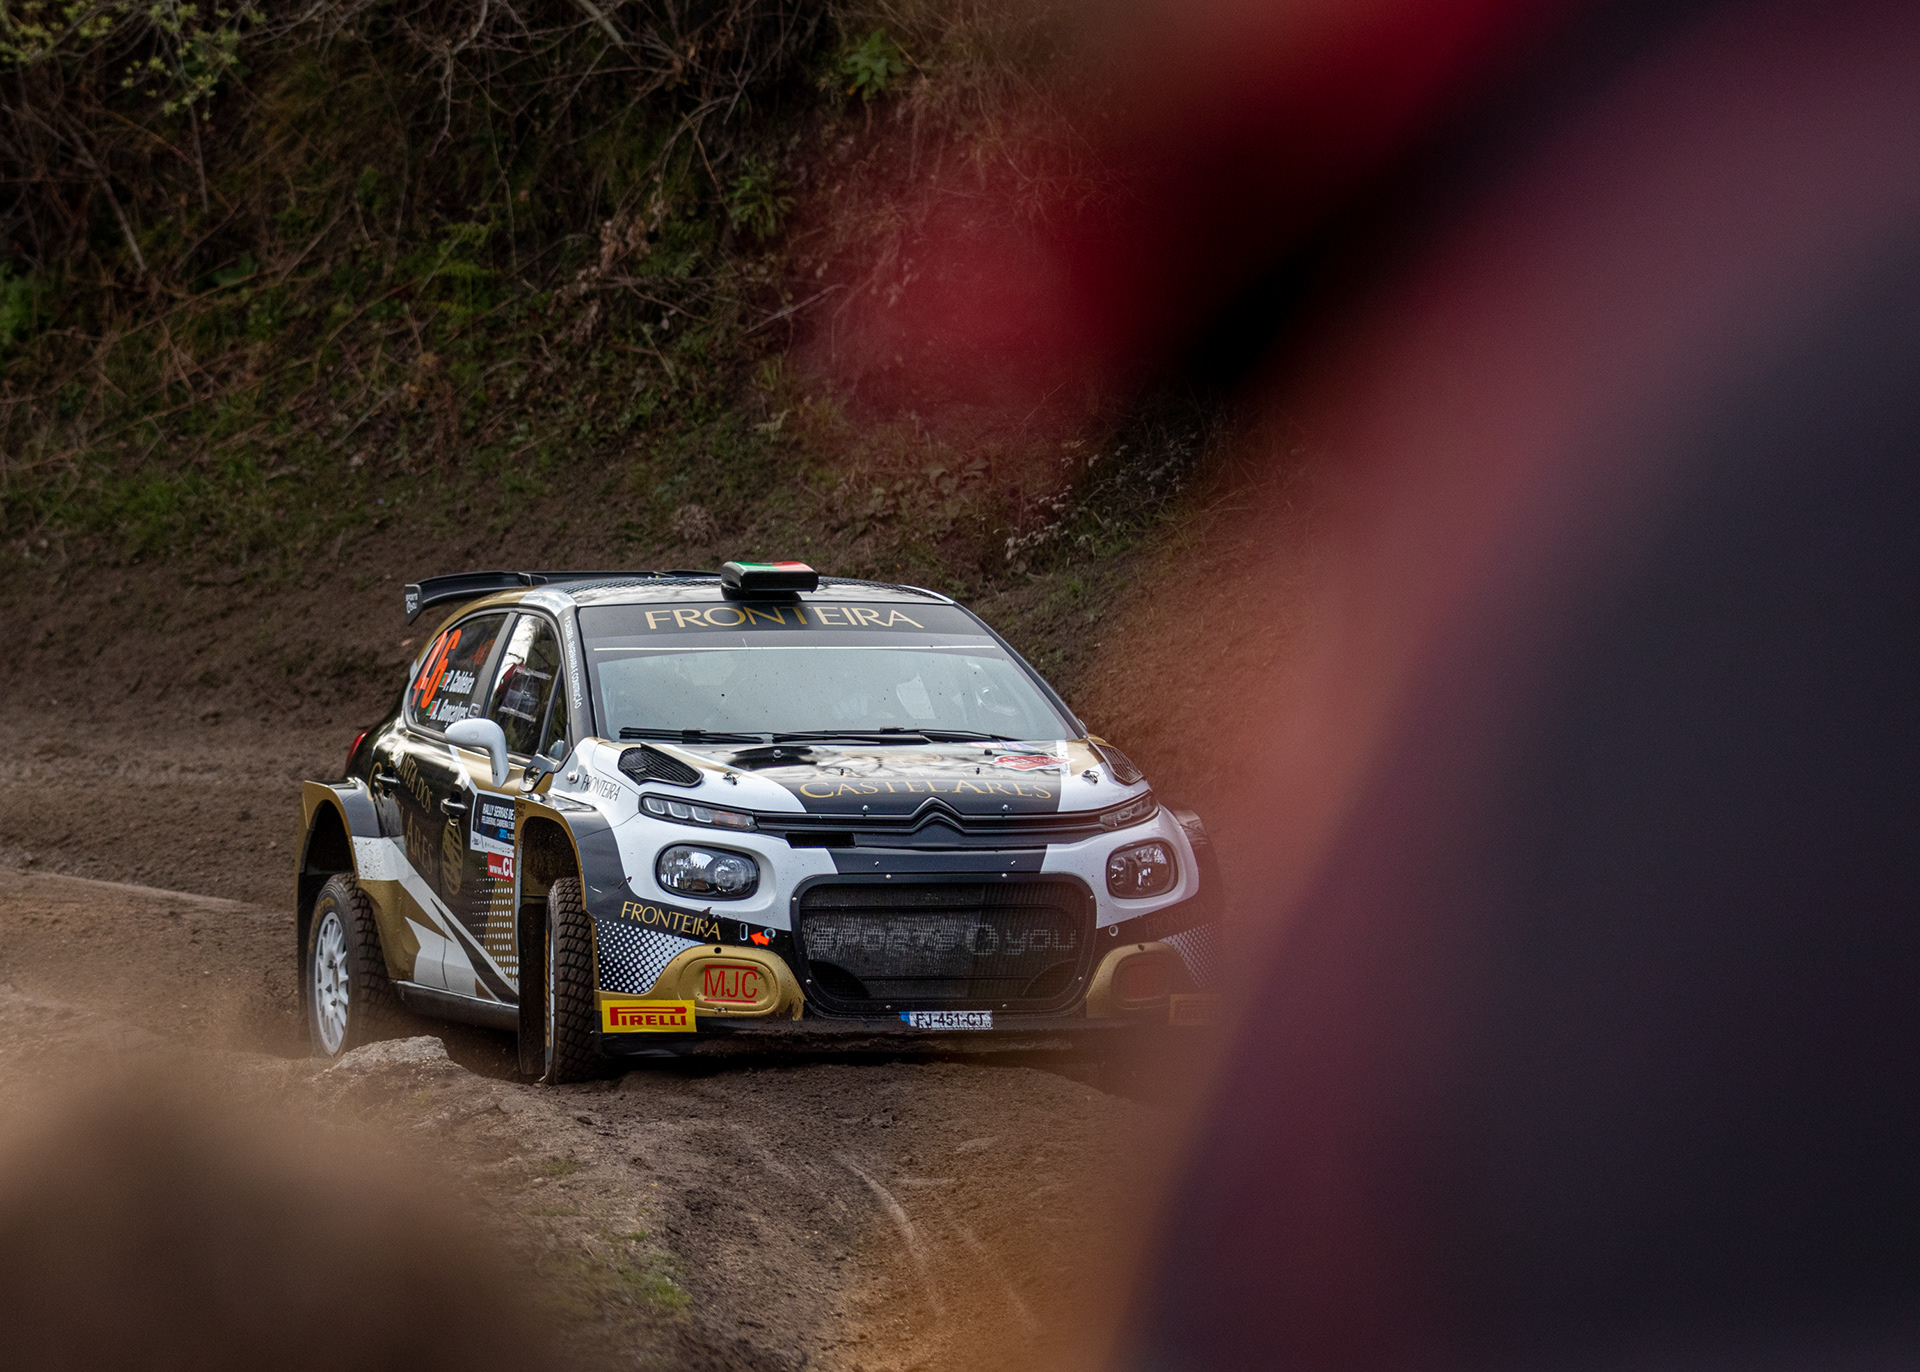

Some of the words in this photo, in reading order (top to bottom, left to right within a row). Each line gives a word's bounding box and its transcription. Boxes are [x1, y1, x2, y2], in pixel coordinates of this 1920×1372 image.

[645, 606, 924, 629] FRONTEIRA
[581, 774, 621, 801] FRONTEIRA
[621, 901, 721, 941] FRONTEIRA
[704, 968, 758, 999] MJC
[610, 1006, 687, 1026] PIRELLI
[916, 1012, 985, 1027] FJ-451-CT
